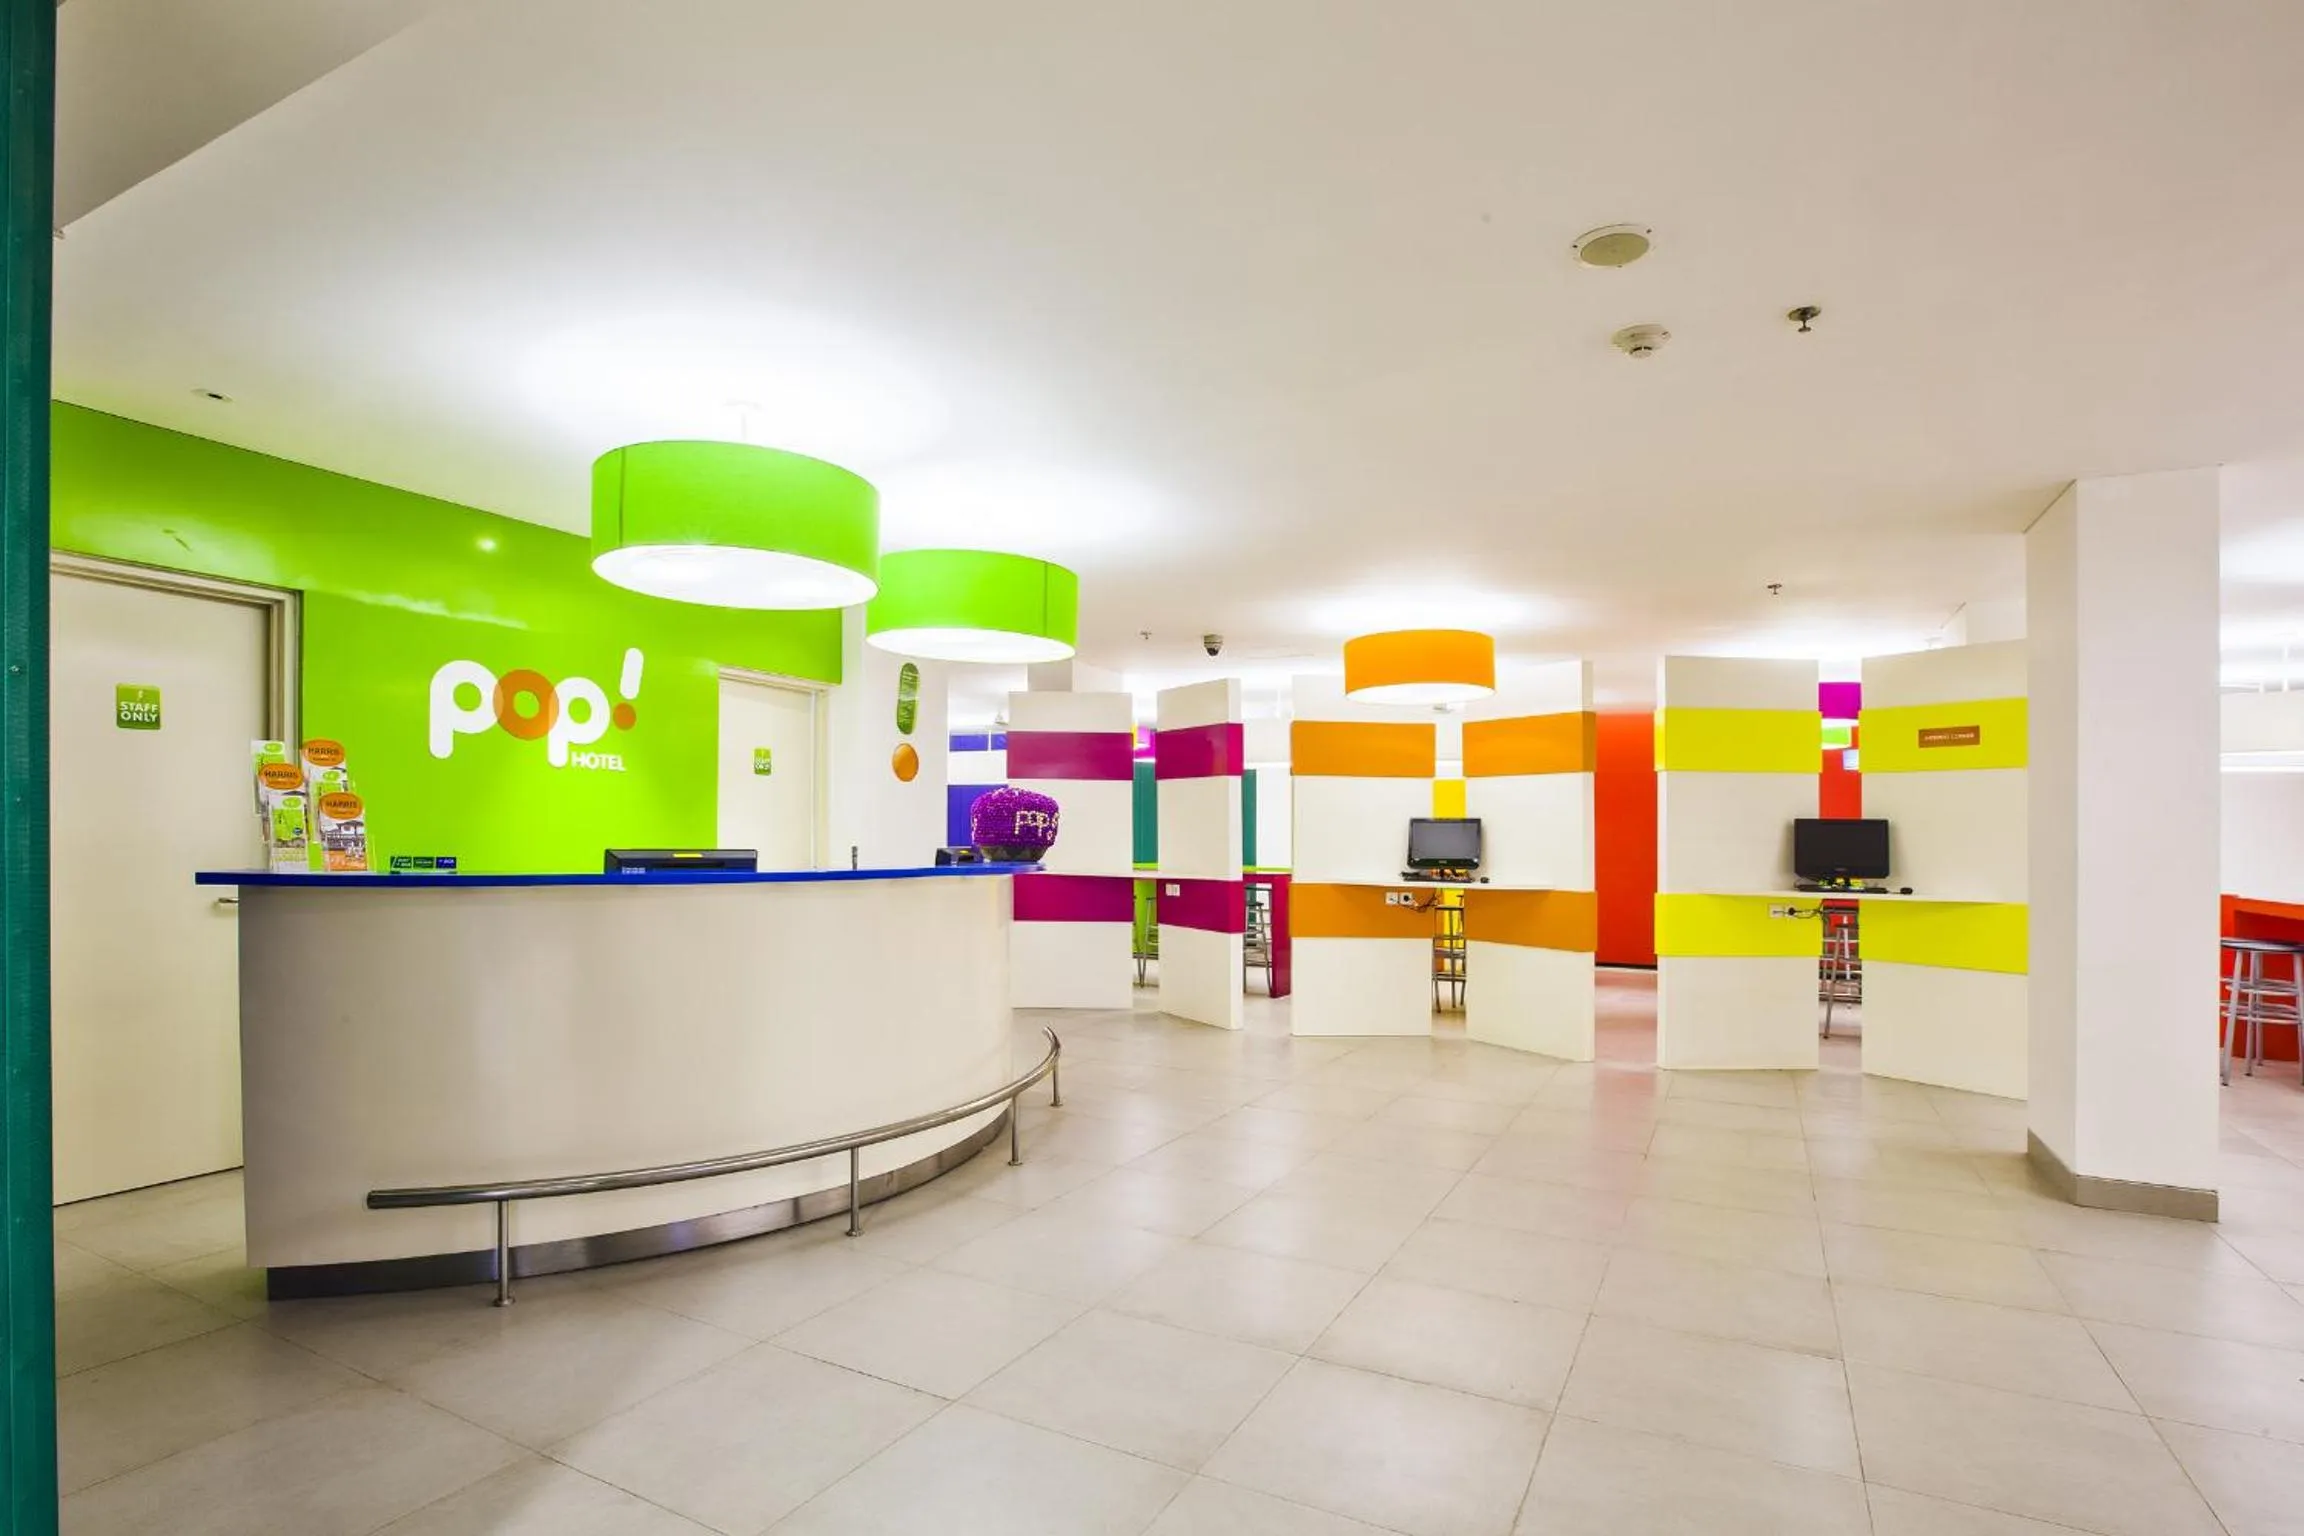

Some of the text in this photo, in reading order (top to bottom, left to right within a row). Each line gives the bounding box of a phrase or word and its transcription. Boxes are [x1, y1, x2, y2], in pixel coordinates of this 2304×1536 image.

[120, 701, 158, 712] STAFF
[429, 648, 644, 767] pop!
[120, 711, 158, 723] ONLY
[571, 752, 626, 771] HOTEL
